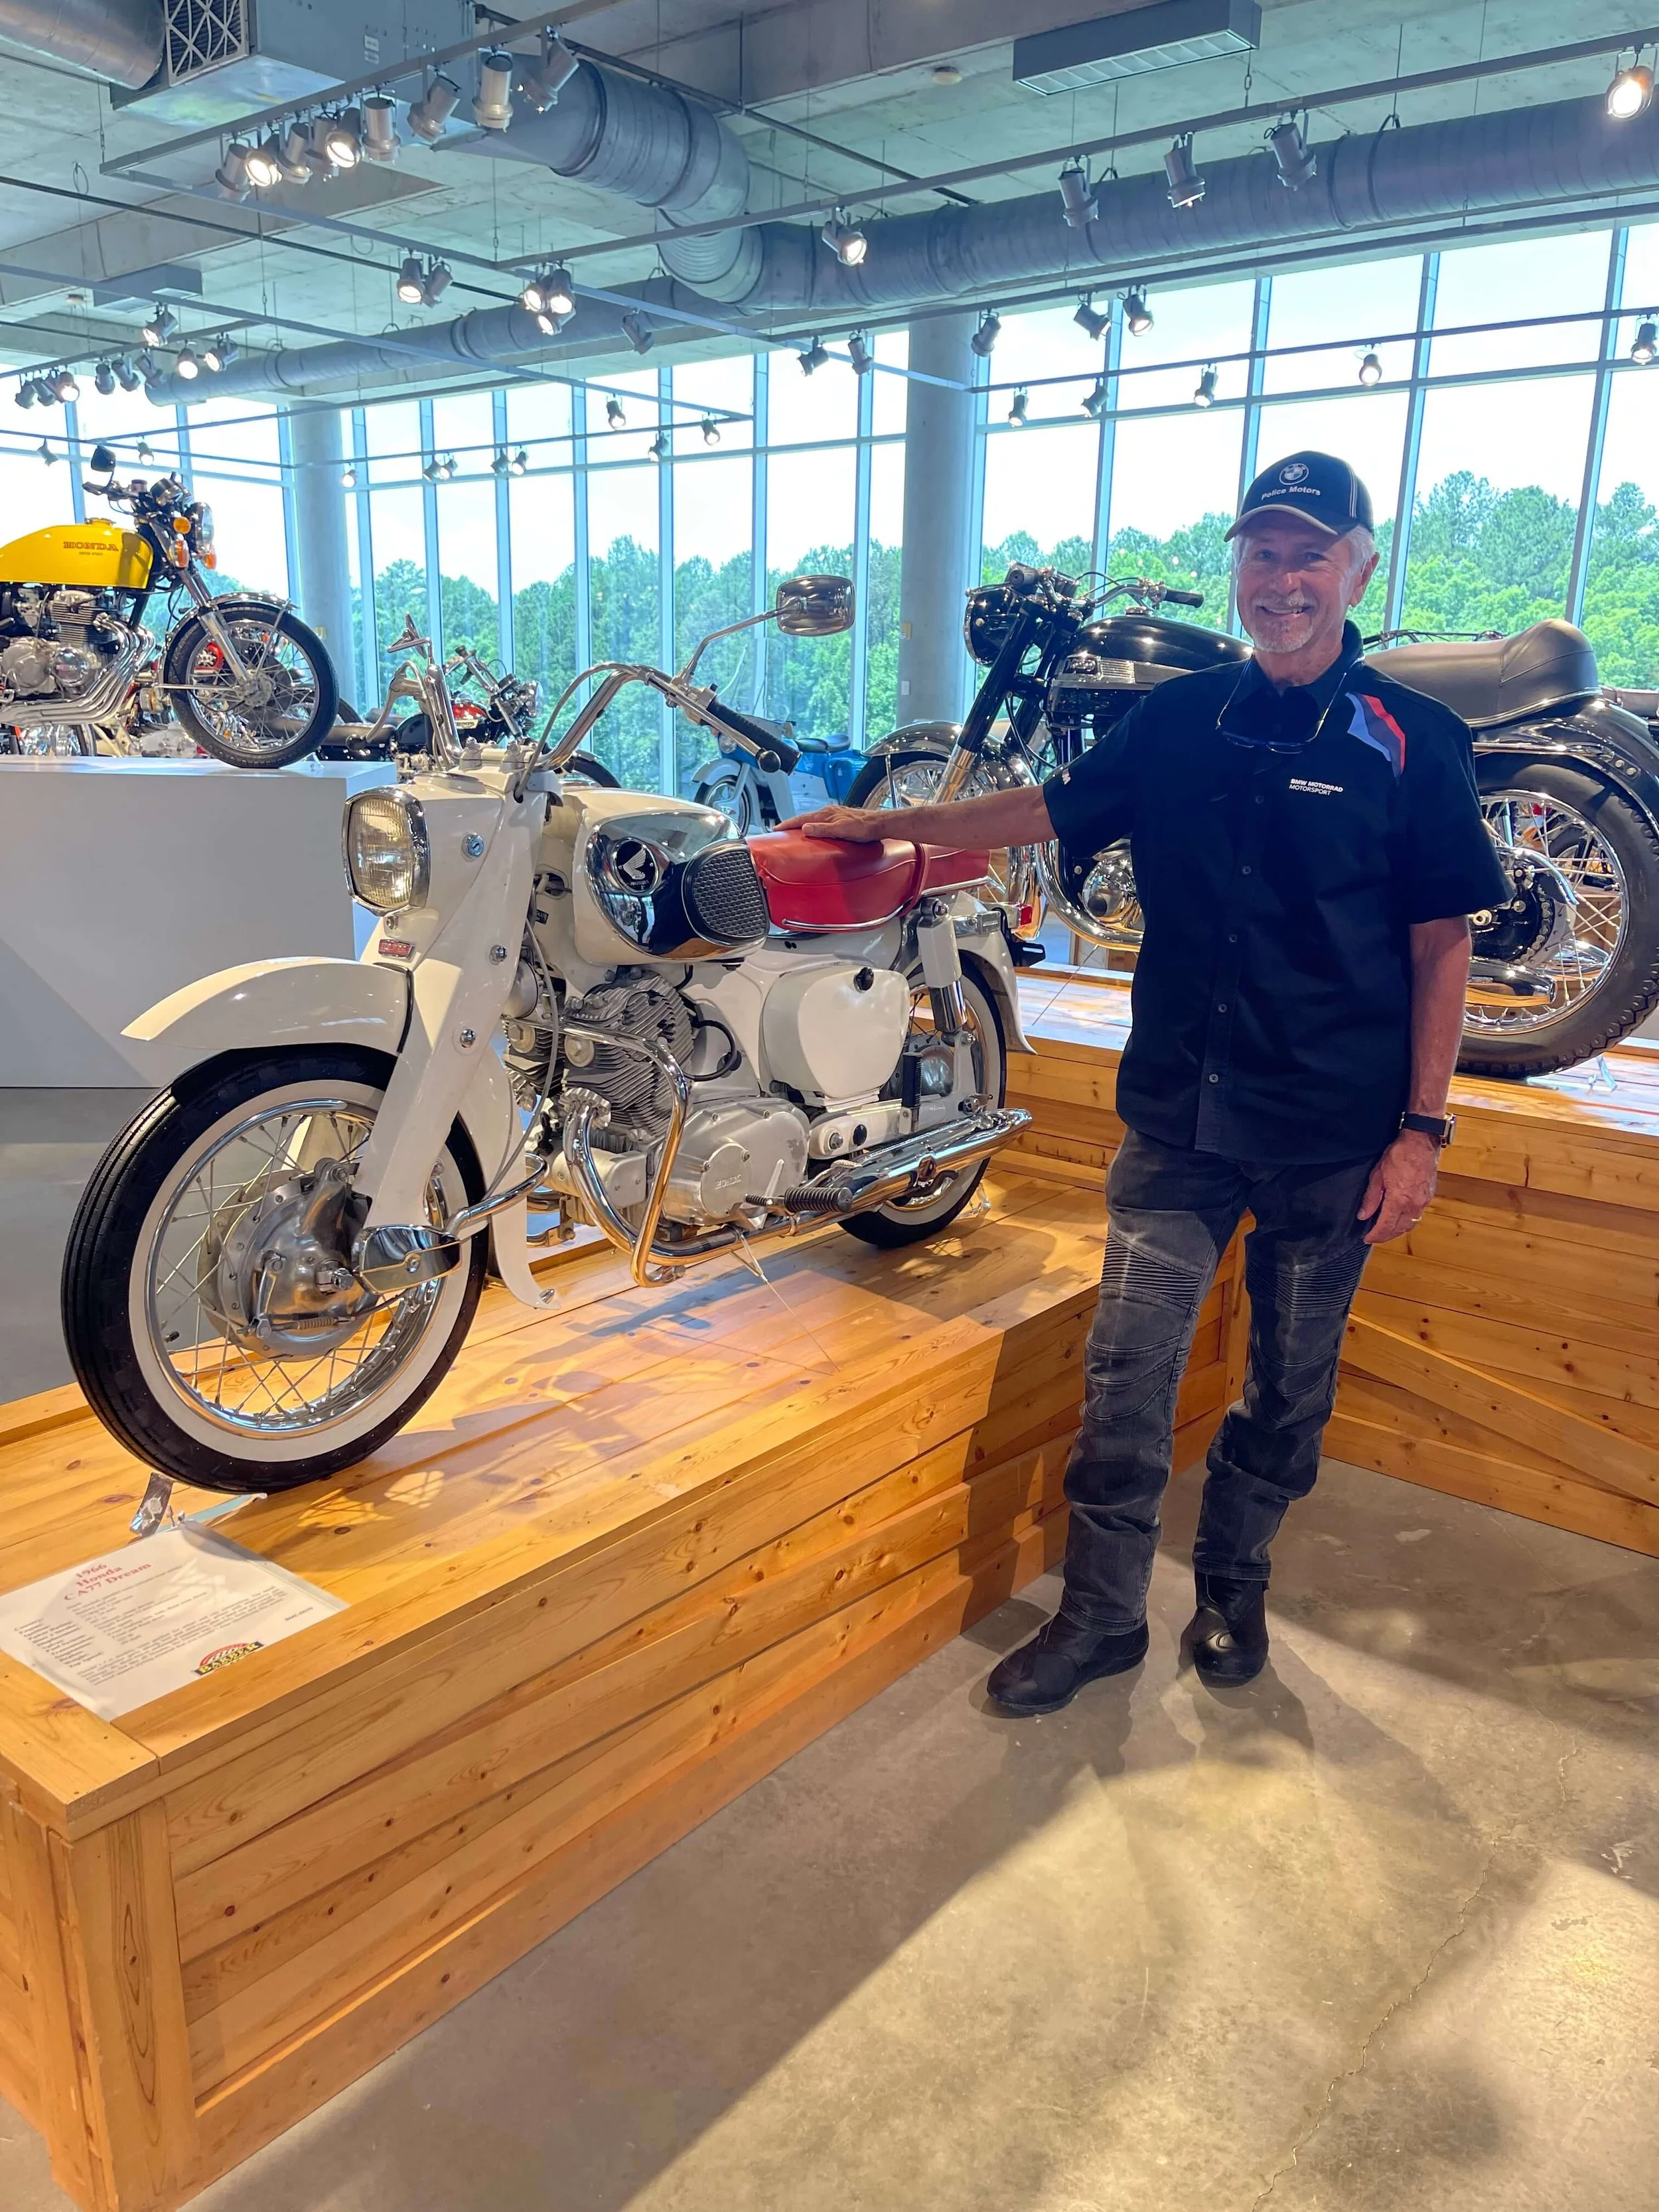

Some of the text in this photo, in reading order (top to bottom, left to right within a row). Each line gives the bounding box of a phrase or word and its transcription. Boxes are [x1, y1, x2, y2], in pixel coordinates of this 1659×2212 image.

[1262, 486, 1321, 500] Police Motors
[63, 541, 119, 552] HONDA
[1289, 784, 1331, 796] MOTORSPORT
[1308, 781, 1344, 792] MOTORRAD
[75, 1562, 108, 1579] 1966
[76, 1566, 123, 1587] Honda
[64, 1582, 102, 1601] CA77
[104, 1563, 152, 1584] Dream
[200, 1643, 259, 1673] BARBER
